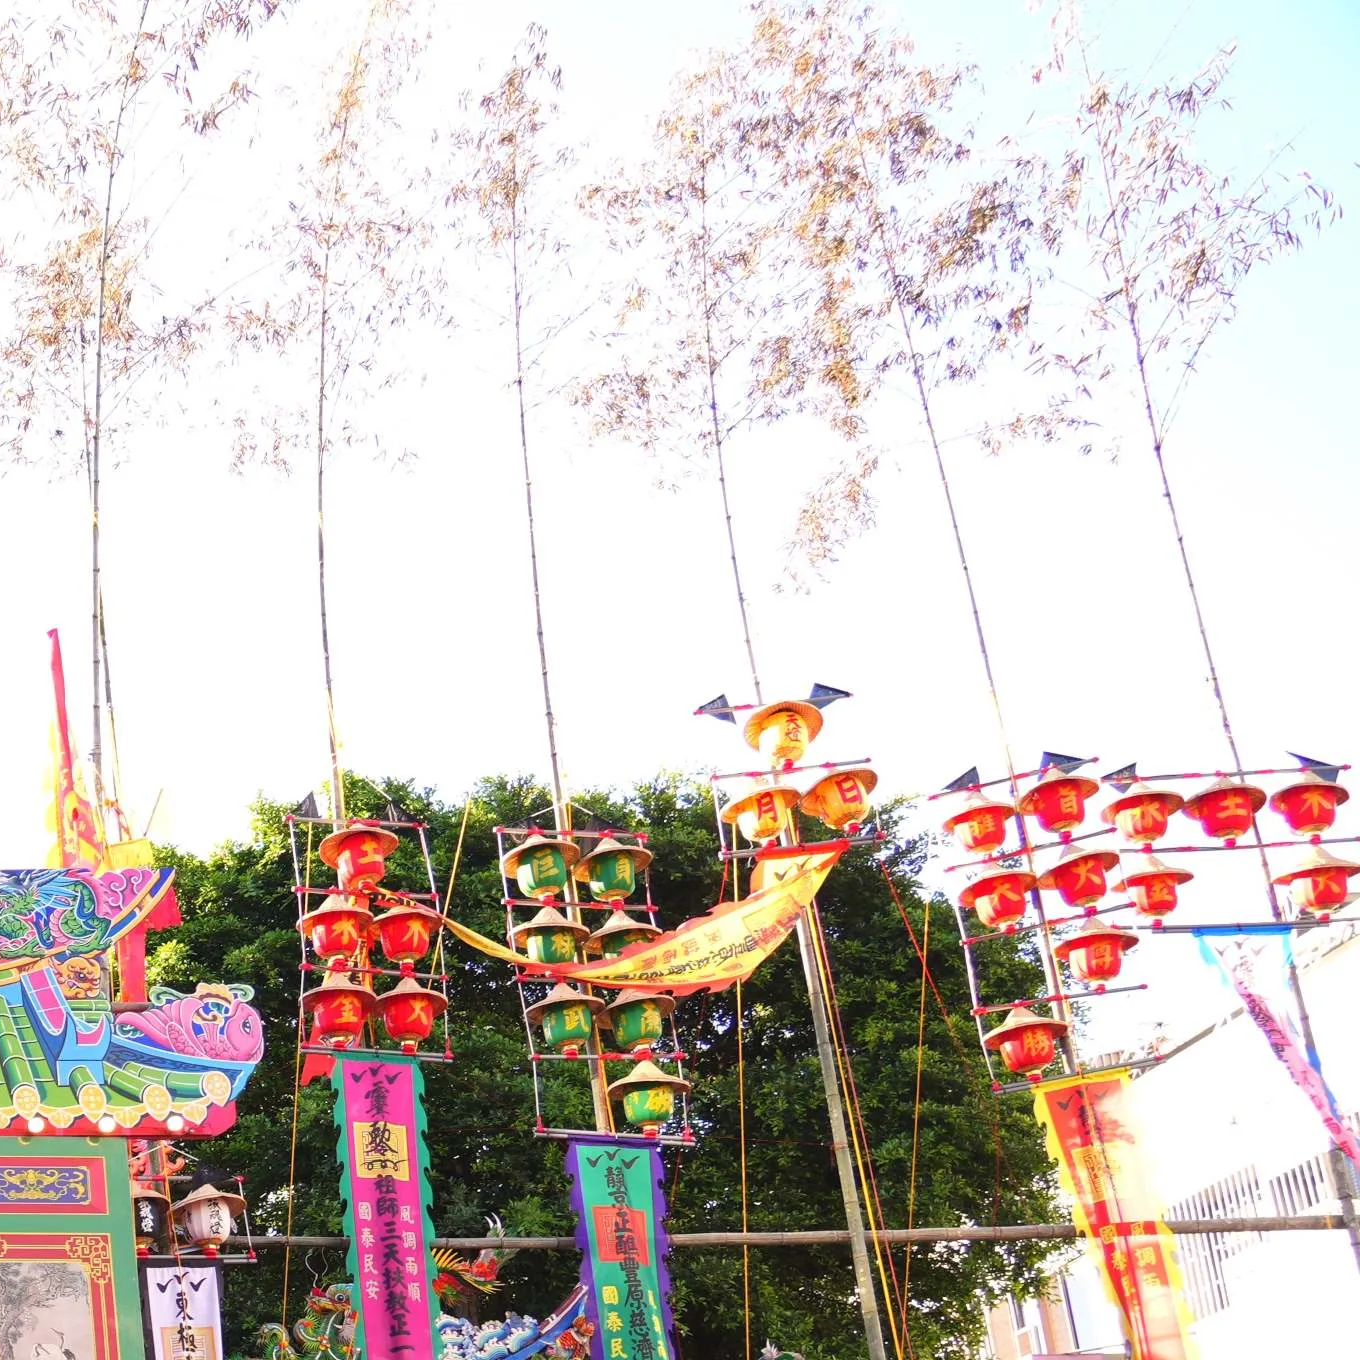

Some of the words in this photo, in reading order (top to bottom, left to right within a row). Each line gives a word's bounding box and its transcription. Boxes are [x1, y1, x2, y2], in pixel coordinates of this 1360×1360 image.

[834, 777, 864, 806] 日
[757, 792, 779, 822] 月
[330, 917, 360, 945] 水
[400, 918, 429, 948] 木
[330, 992, 363, 1024] 金
[357, 1201, 382, 1300] 國泰民安
[399, 1205, 423, 1303] 風調雨順
